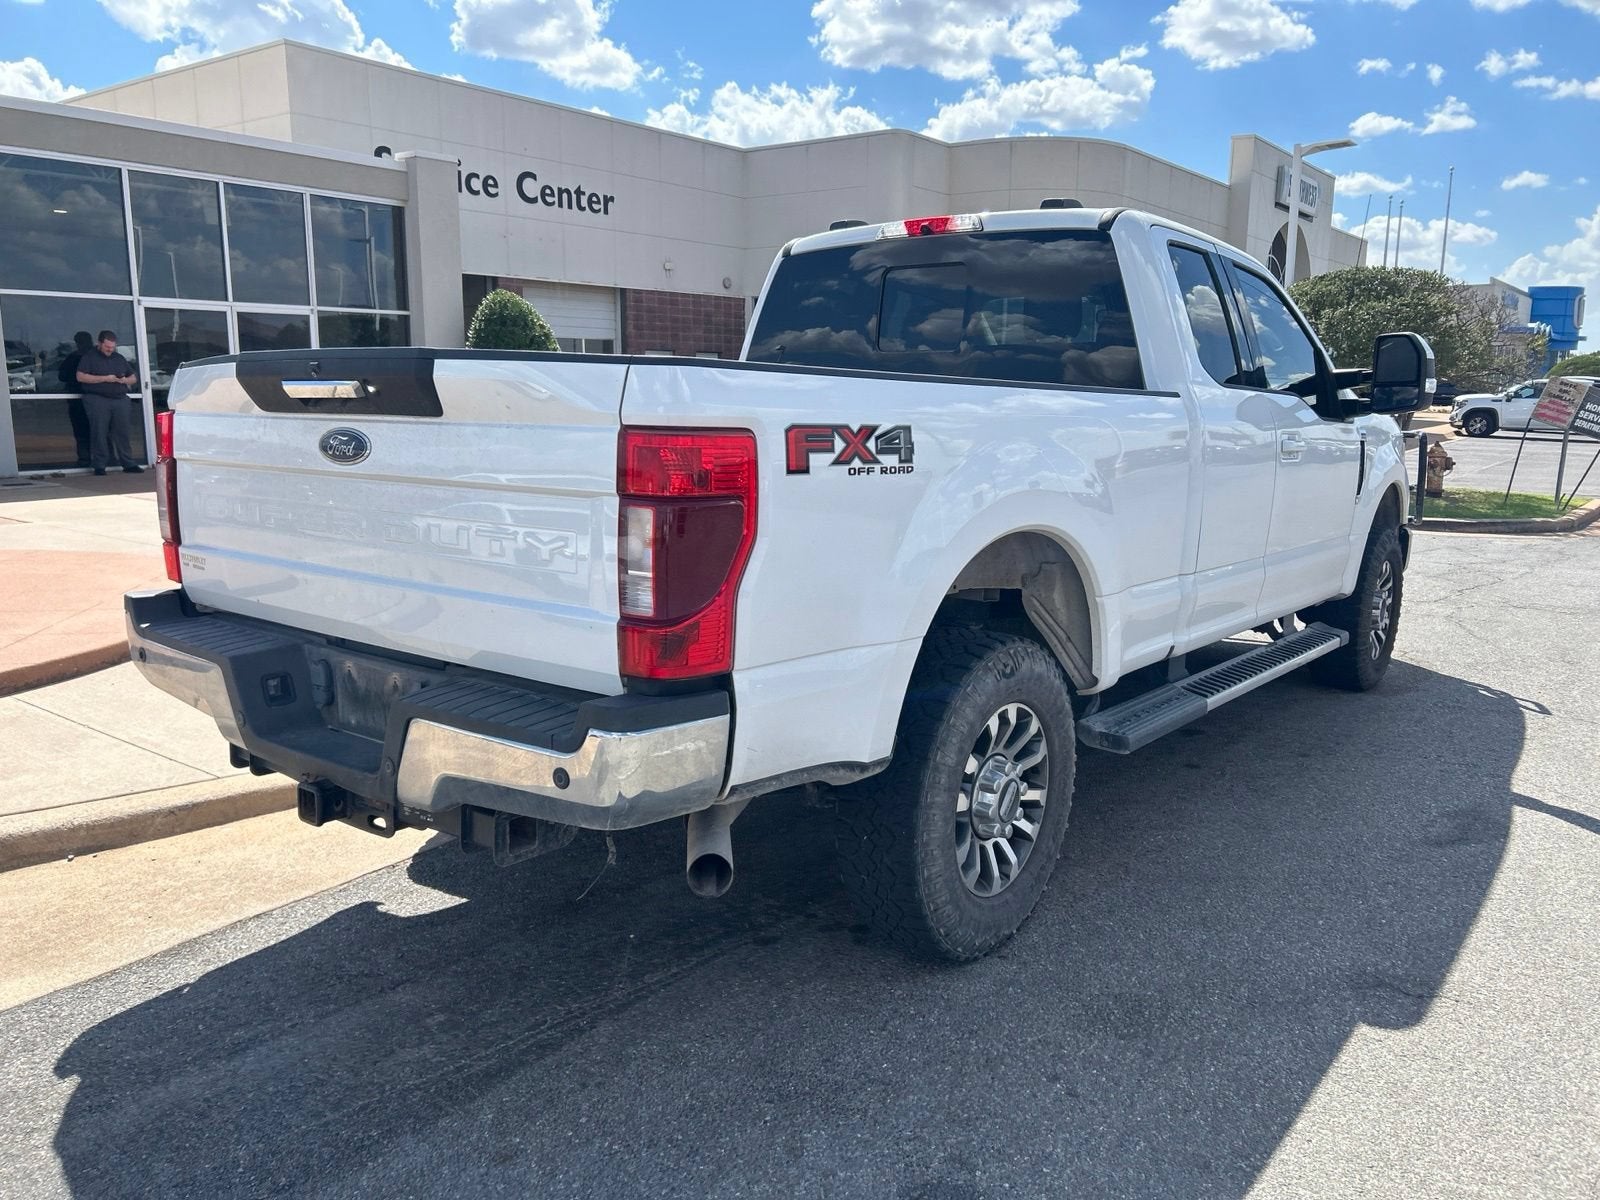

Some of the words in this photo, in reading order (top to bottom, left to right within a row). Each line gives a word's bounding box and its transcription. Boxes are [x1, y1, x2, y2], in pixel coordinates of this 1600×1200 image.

[516, 170, 616, 216] Center
[327, 434, 356, 456] Ford
[784, 423, 915, 475] FX4
[847, 466, 875, 476] OFF
[880, 465, 914, 475] ROAD
[384, 521, 571, 562] DUTY
